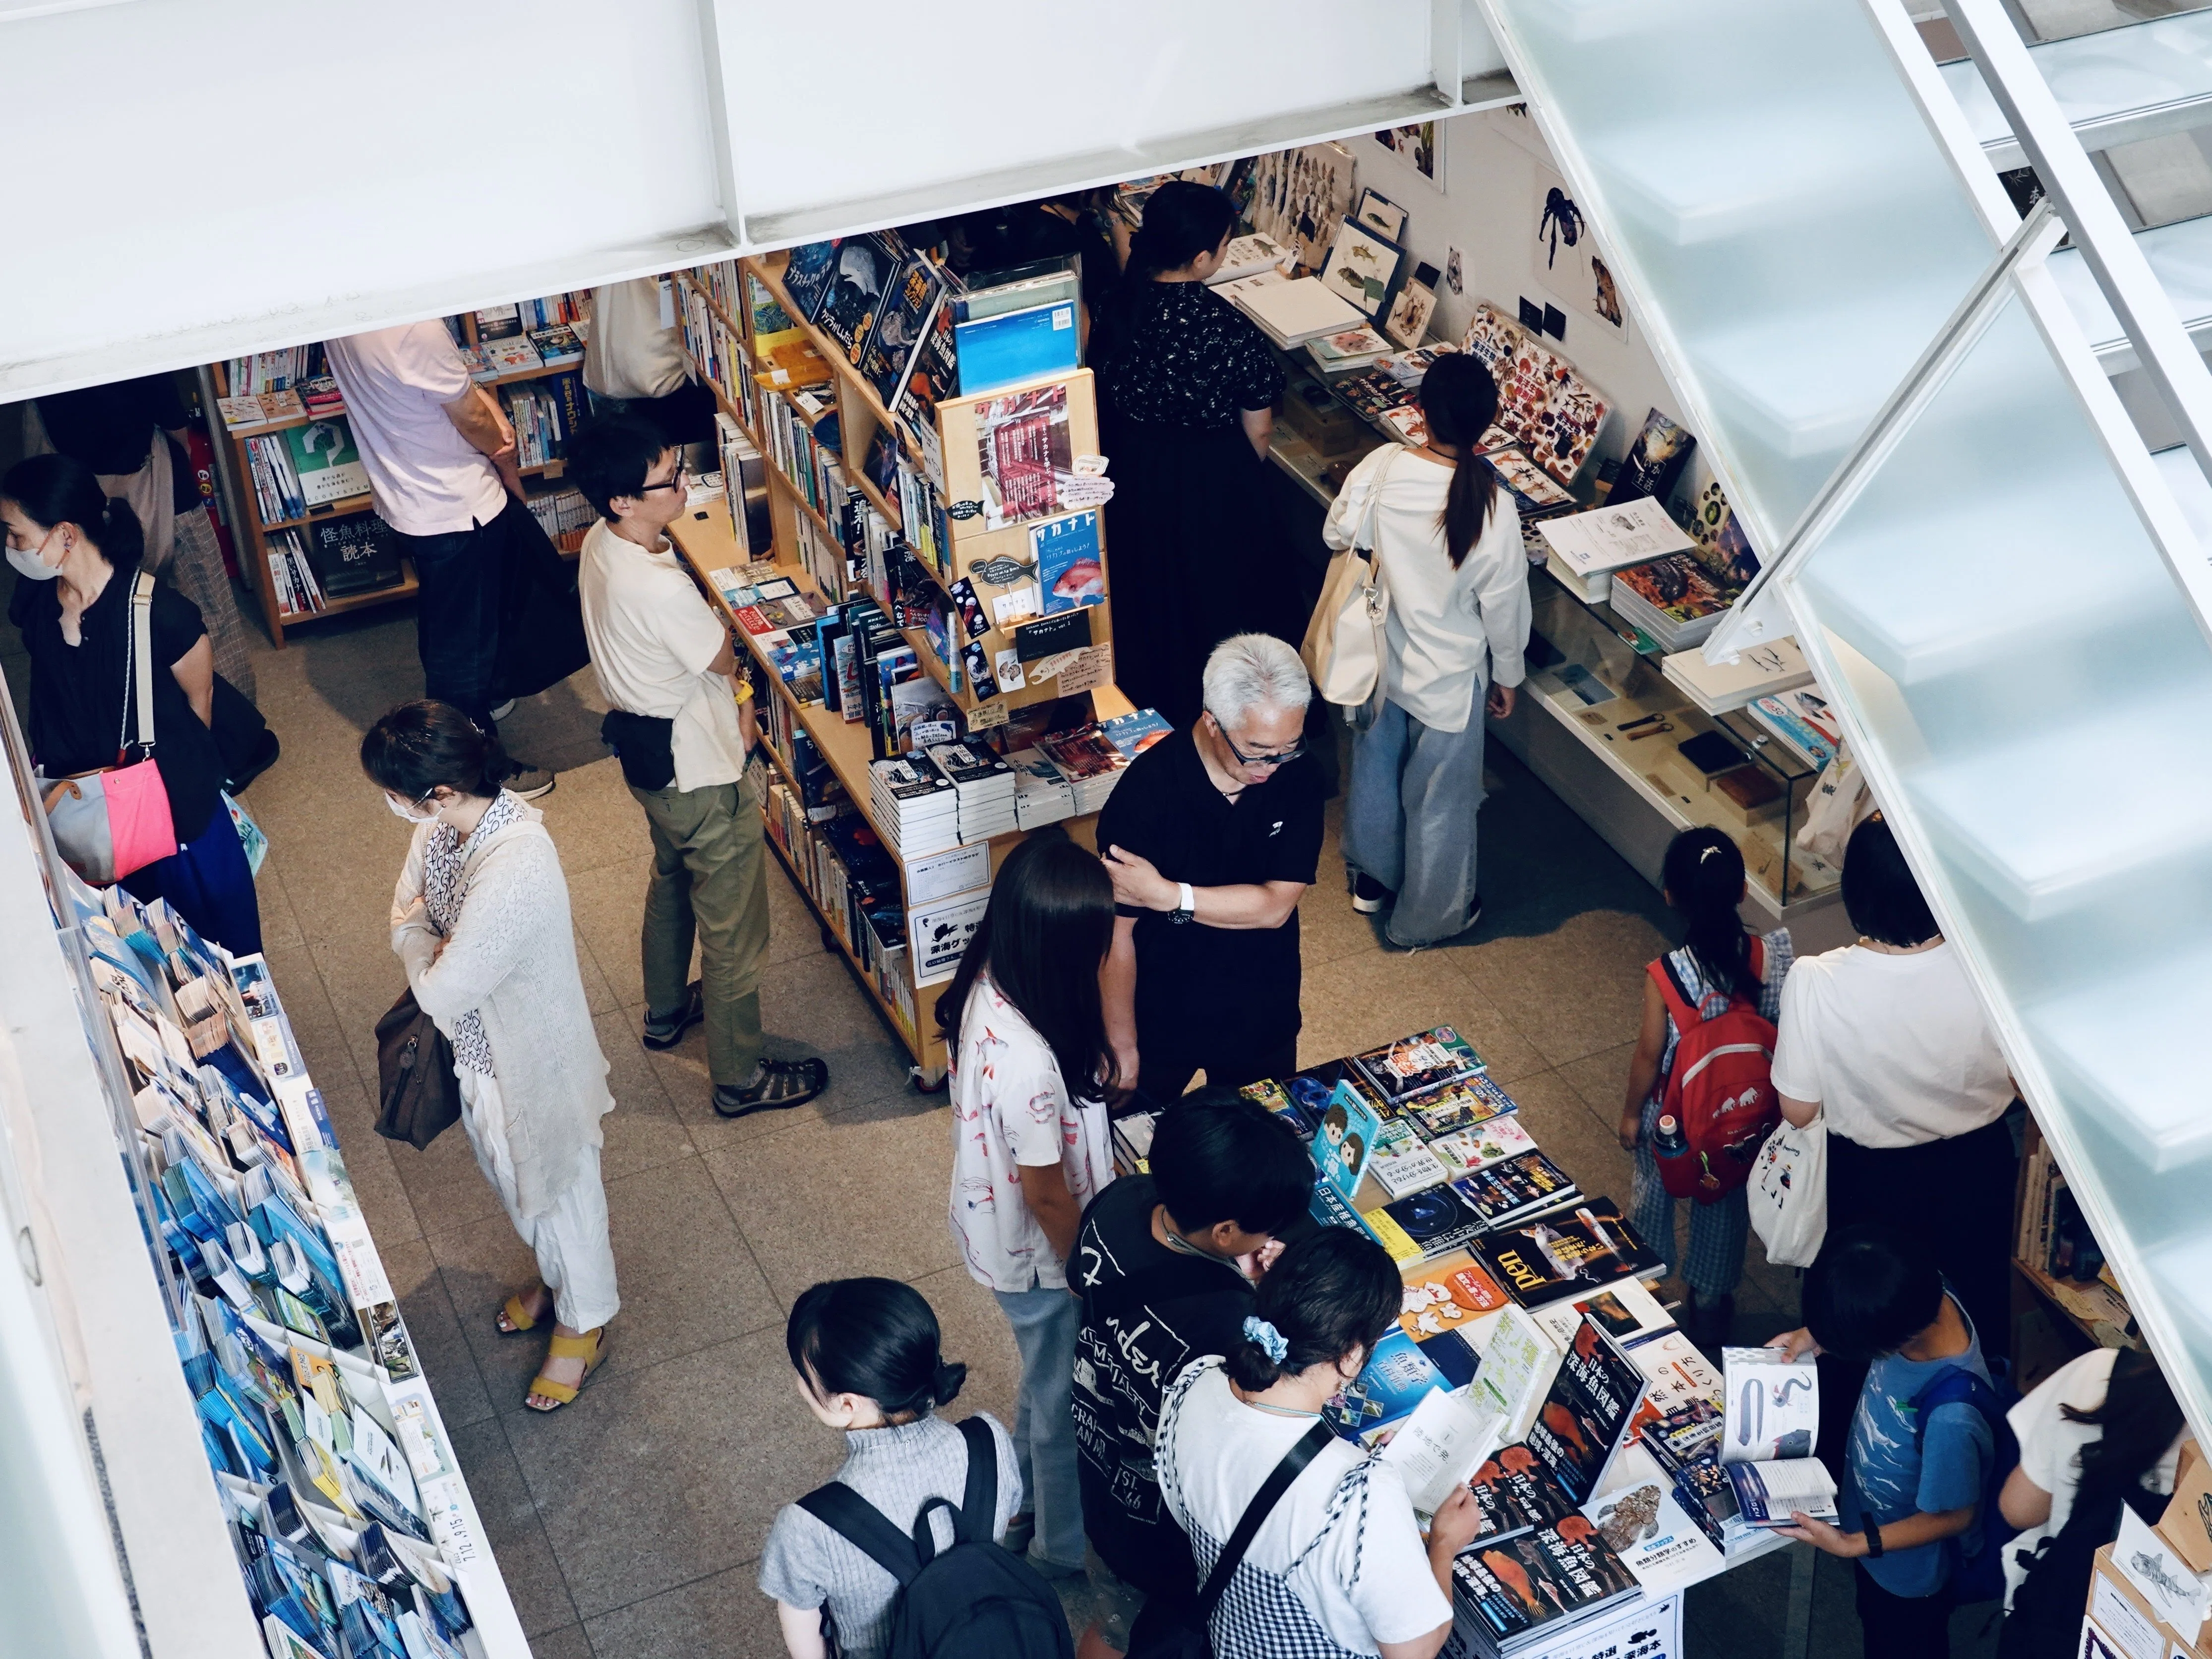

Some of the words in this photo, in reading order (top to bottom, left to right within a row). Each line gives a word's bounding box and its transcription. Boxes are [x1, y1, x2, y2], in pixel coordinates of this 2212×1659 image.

[821, 308, 853, 349] クジラがしんだら
[976, 385, 1065, 418] サカナト
[321, 518, 388, 544] 怪魚料理
[1037, 514, 1094, 541] サカナト
[341, 542, 377, 562] 読本
[1386, 1157, 1434, 1176] 世界が分かる
[1391, 1163, 1439, 1184] 生物を分けると
[1497, 1249, 1547, 1291] pen
[1376, 1361, 1407, 1391] 百科事典
[1390, 1352, 1429, 1385] 魚類学
[1588, 1358, 1610, 1383] 日本の
[1566, 1352, 1620, 1421] 深海魚図鑑
[1474, 1485, 1496, 1509] 日本の
[1512, 1474, 1536, 1498] 日本の
[459, 1543, 476, 1561] 7.12
[1538, 1528, 1603, 1598] 深海魚図鑑
[1569, 1544, 1596, 1569] 日本の
[1636, 1538, 1696, 1566] 魚類分類学のすすめ
[1592, 1645, 1617, 1659] 特選
[1624, 1639, 1662, 1659] 深海本
